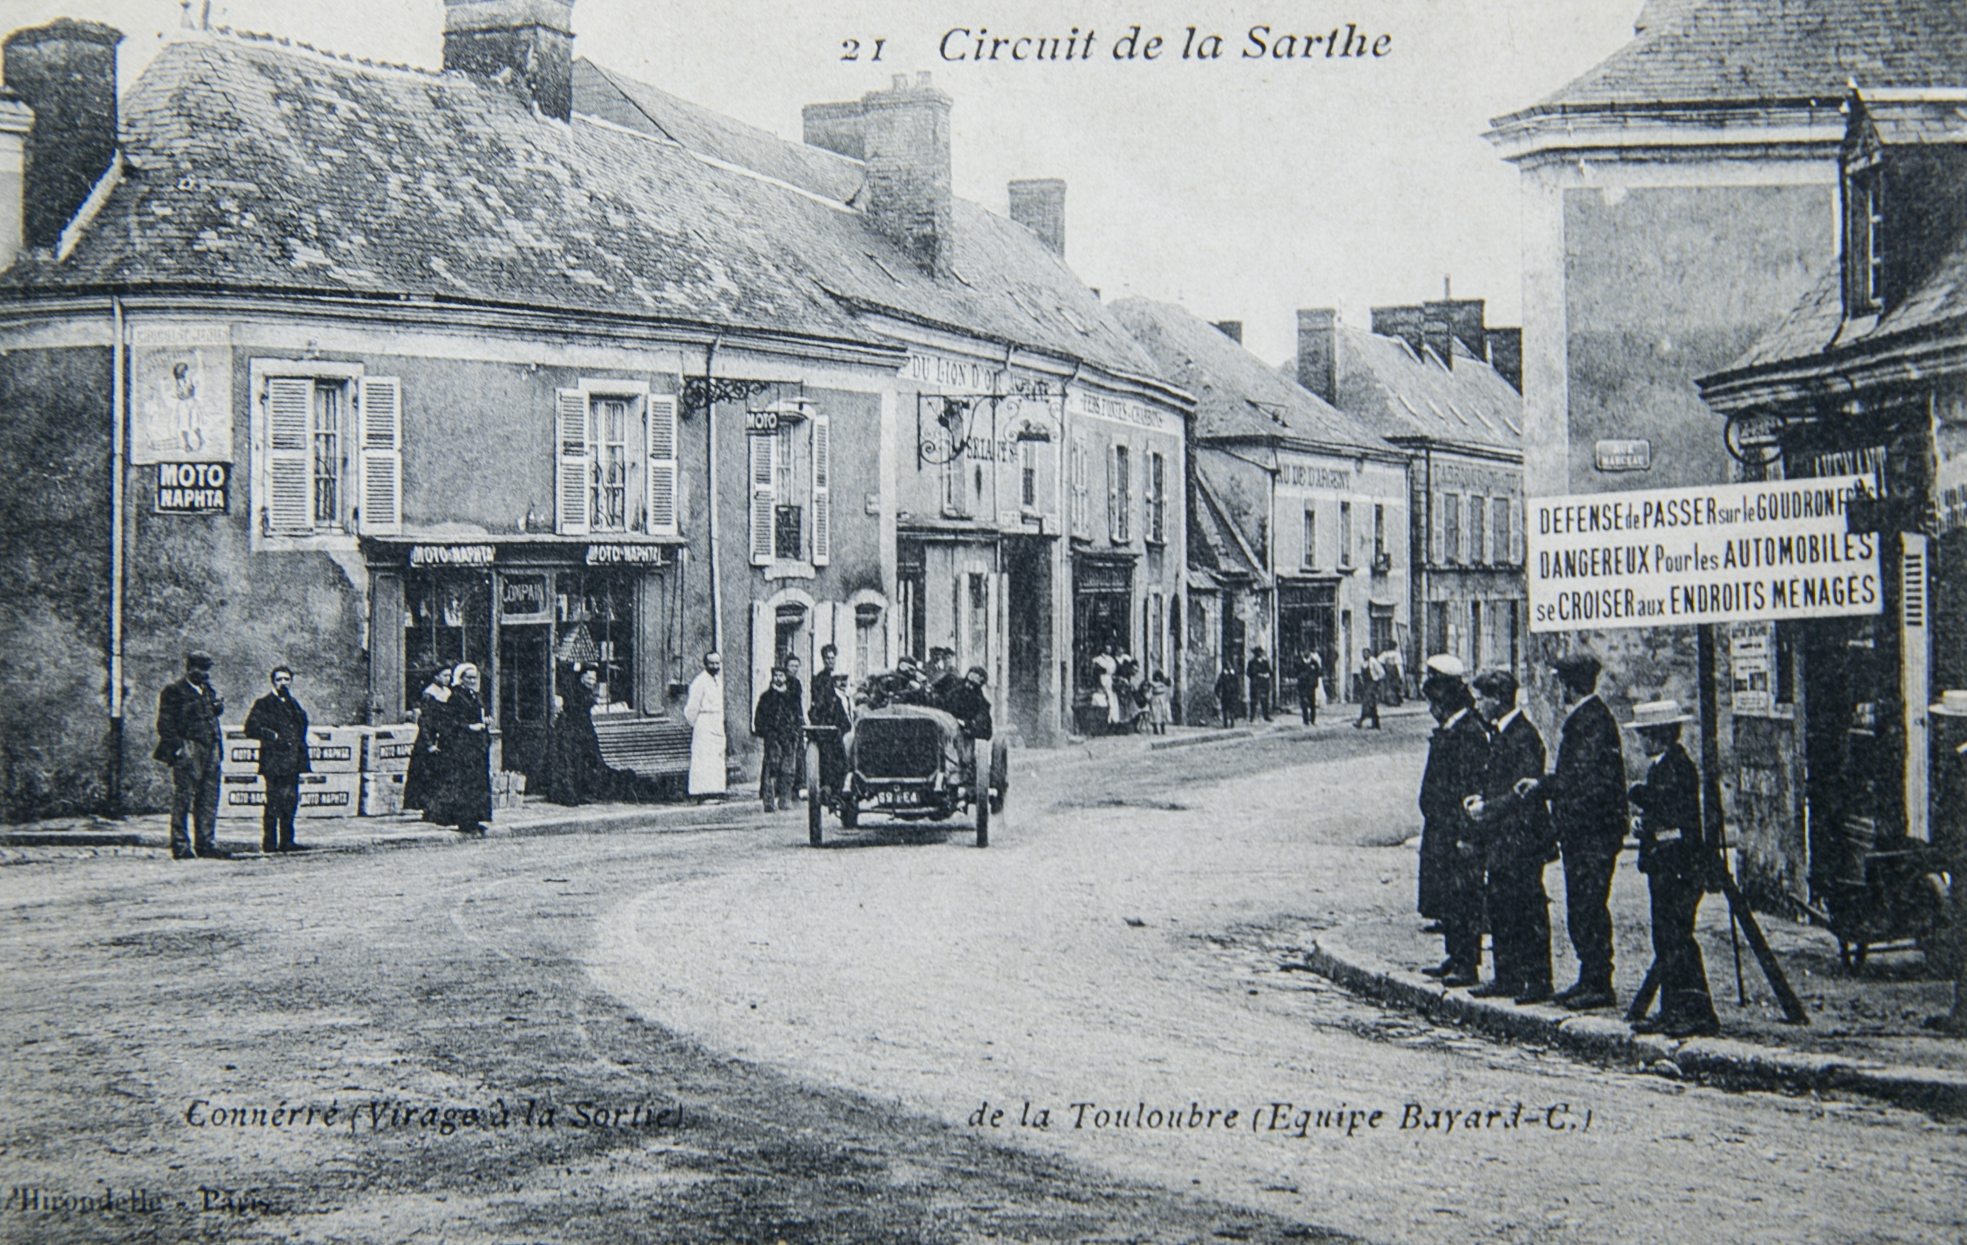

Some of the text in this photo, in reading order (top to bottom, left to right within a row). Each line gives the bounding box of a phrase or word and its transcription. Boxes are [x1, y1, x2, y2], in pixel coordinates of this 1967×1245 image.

[937, 357, 967, 387] LION
[745, 412, 778, 430] MOTO
[160, 463, 226, 488] MOTO
[160, 489, 225, 508] NAPHTA
[1625, 502, 1640, 529] de
[1643, 497, 1717, 529] PASSER
[1718, 507, 1741, 524] sur
[1743, 495, 1755, 522] le
[1540, 532, 1873, 579] DANGEREUX Pour les AUTOMOBILES
[1536, 603, 1555, 622] se
[1559, 588, 1635, 621] CROISER
[1638, 599, 1665, 617] aux
[1671, 580, 1766, 614] ENDROITS
